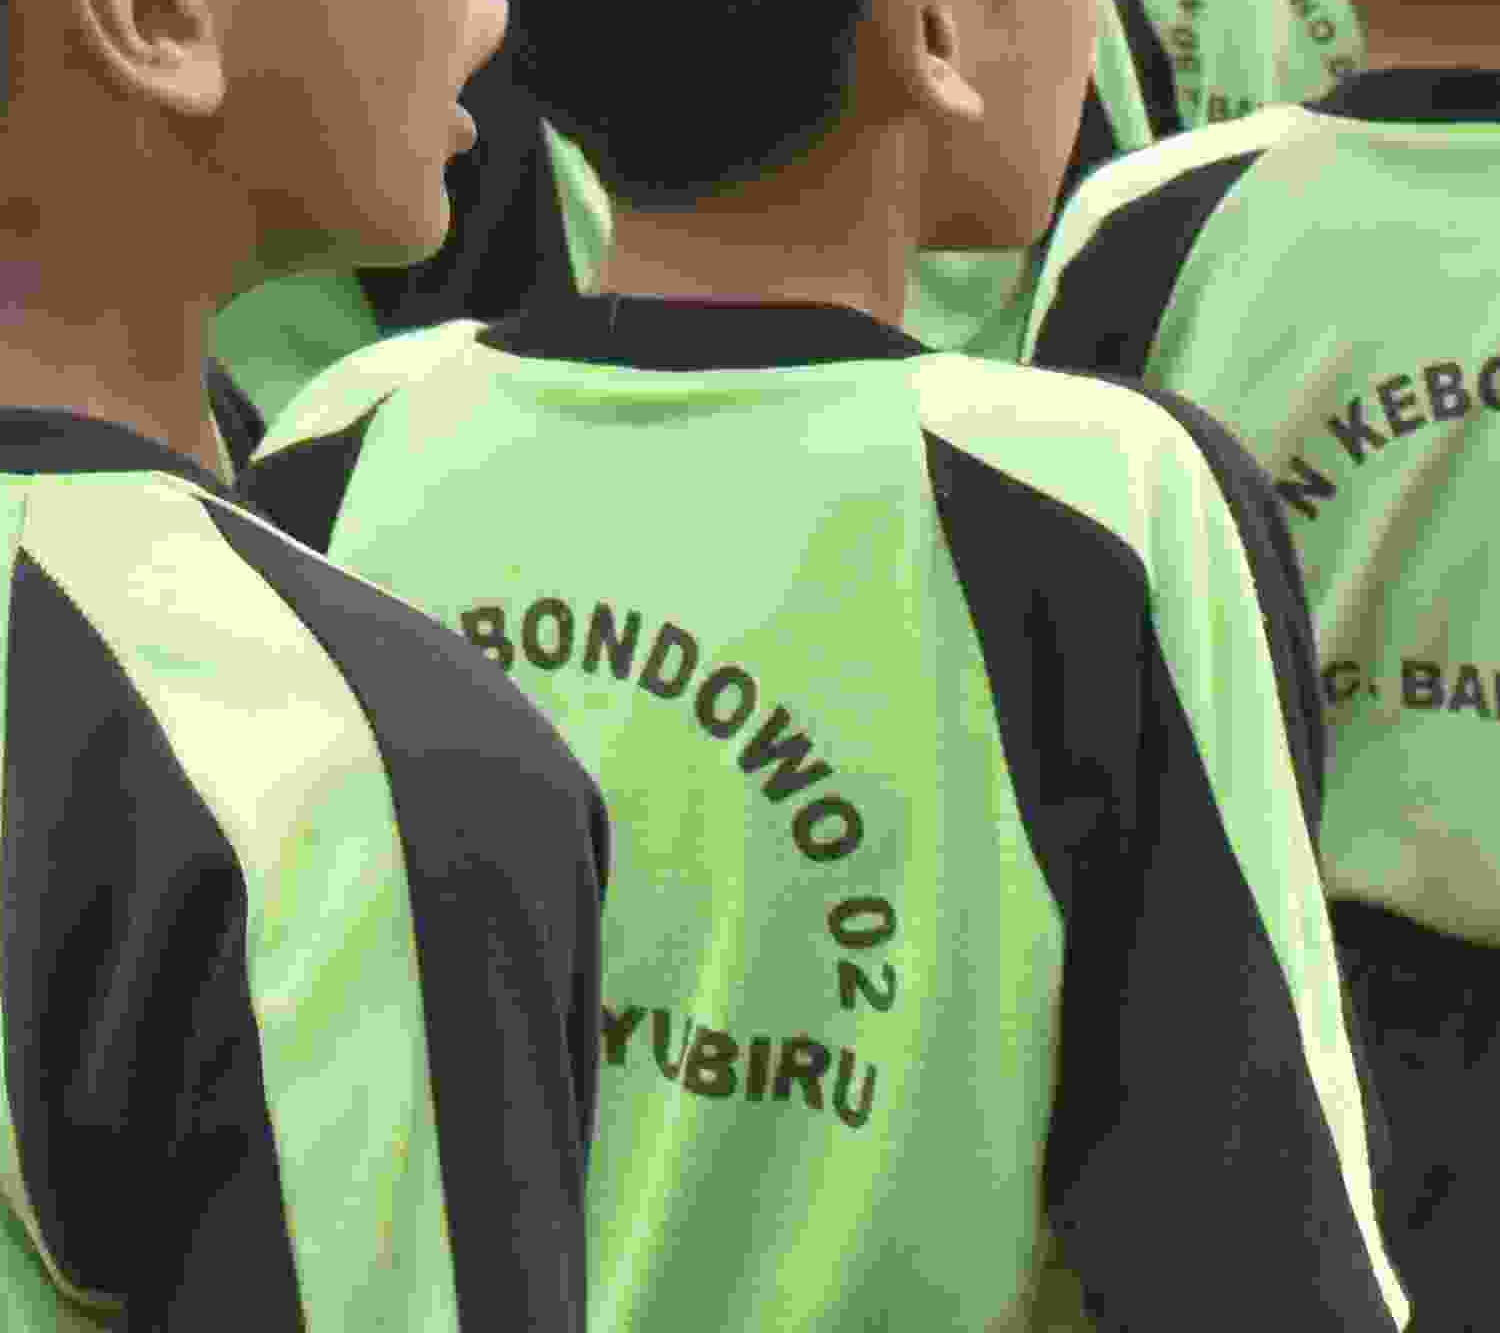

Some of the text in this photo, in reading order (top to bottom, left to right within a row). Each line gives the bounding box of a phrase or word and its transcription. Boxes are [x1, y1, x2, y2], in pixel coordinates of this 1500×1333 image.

[460, 597, 897, 1013] BONDOWO 02
[600, 1004, 876, 1129] YUBIRU
